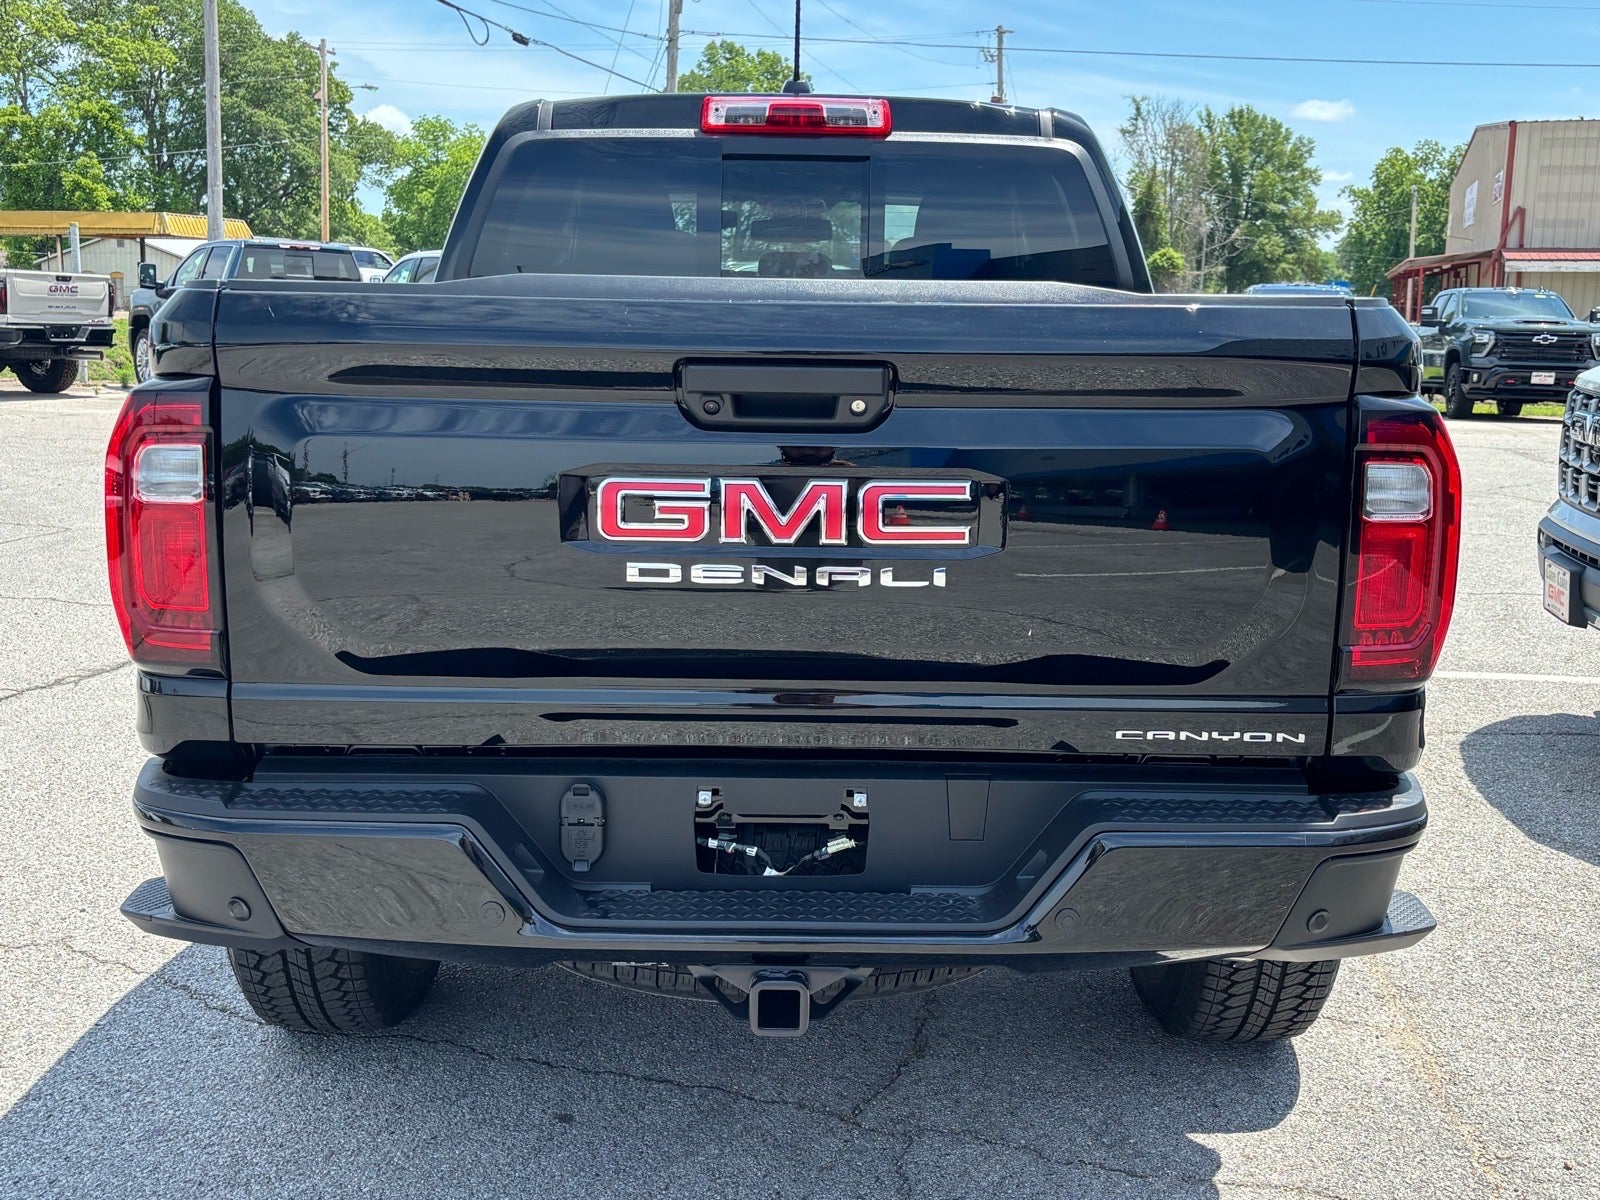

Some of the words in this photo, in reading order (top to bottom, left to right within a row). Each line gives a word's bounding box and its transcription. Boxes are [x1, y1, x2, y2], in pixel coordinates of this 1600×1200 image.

[49, 285, 78, 293] GMC
[597, 477, 972, 545] GMC
[626, 562, 947, 587] DENALI
[1549, 583, 1565, 608] GMC
[1115, 730, 1305, 743] CANYON
